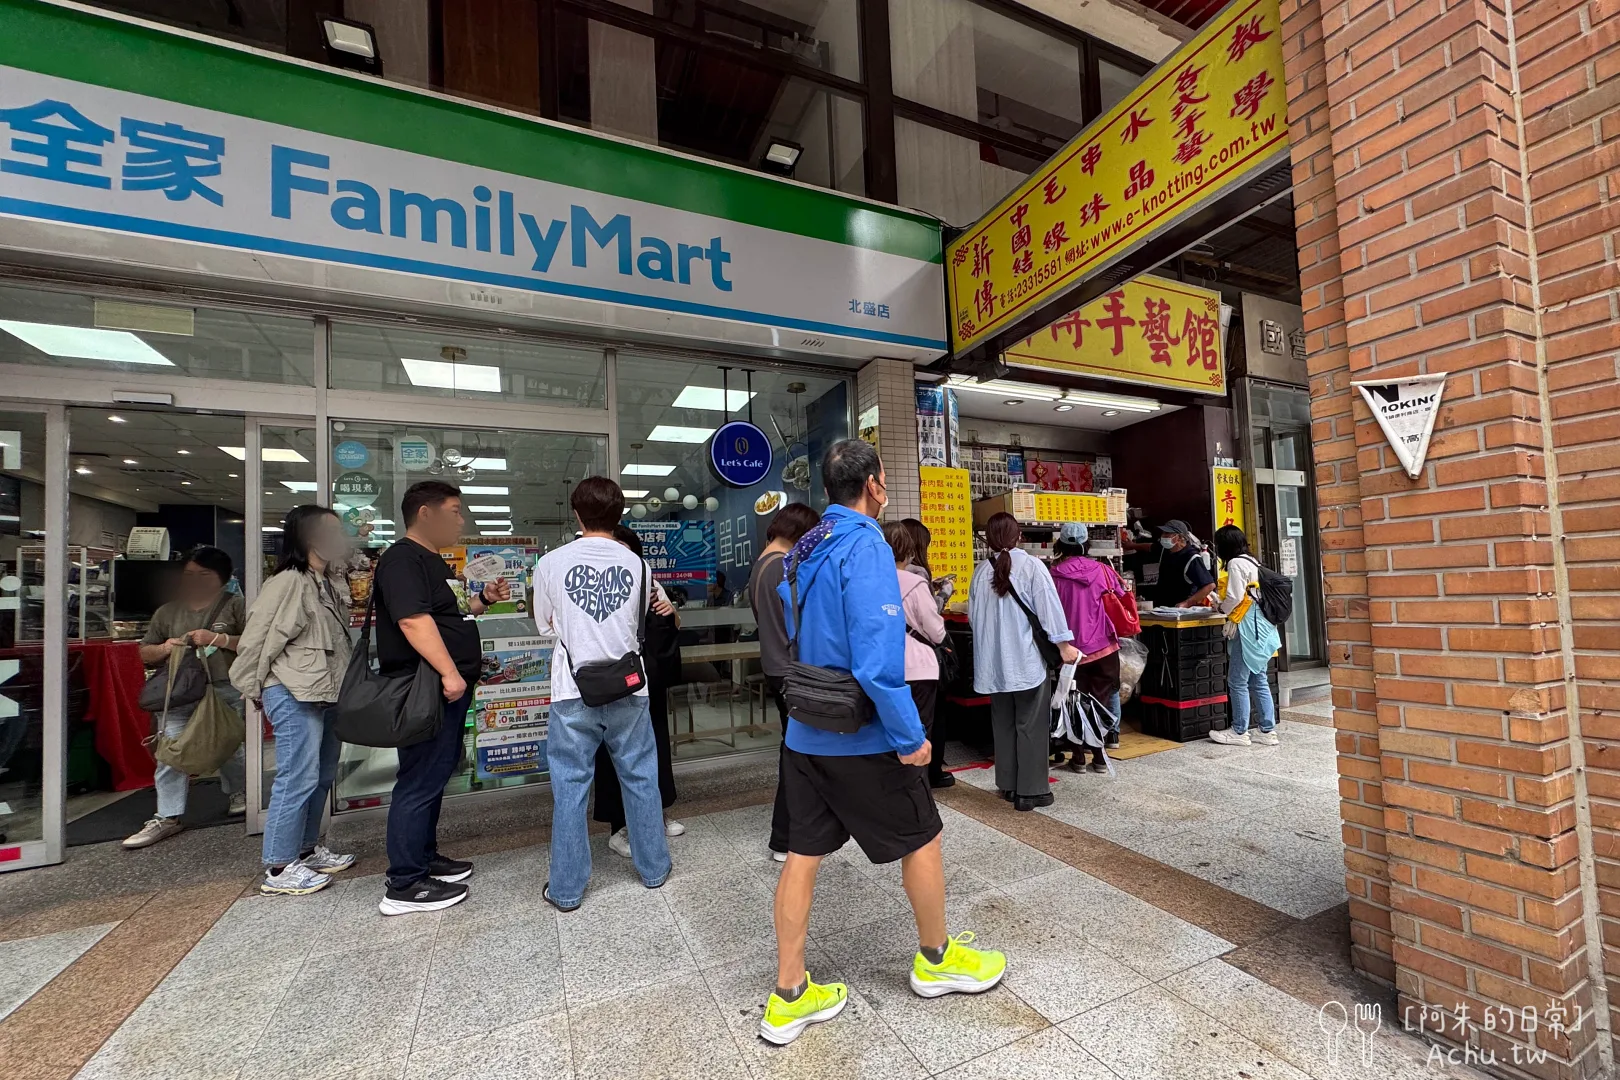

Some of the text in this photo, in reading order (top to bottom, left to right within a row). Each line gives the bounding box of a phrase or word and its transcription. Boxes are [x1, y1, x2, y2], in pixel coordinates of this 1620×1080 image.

[1225, 14, 1274, 120] 教學
[1167, 64, 1214, 165] 各式手藝
[1080, 142, 1111, 228] 串珠
[1120, 107, 1156, 201] 水晶
[0, 98, 733, 292] 全家 FamilyMart
[1042, 175, 1070, 254] 毛線
[1010, 203, 1034, 278] 中國結
[848, 298, 890, 319] 北盛店
[339, 483, 374, 493] 喝現煮
[403, 448, 429, 459] 全家
[721, 458, 764, 468] Let's Café
[564, 564, 634, 598] BEAMS
[567, 588, 630, 624] HEART
